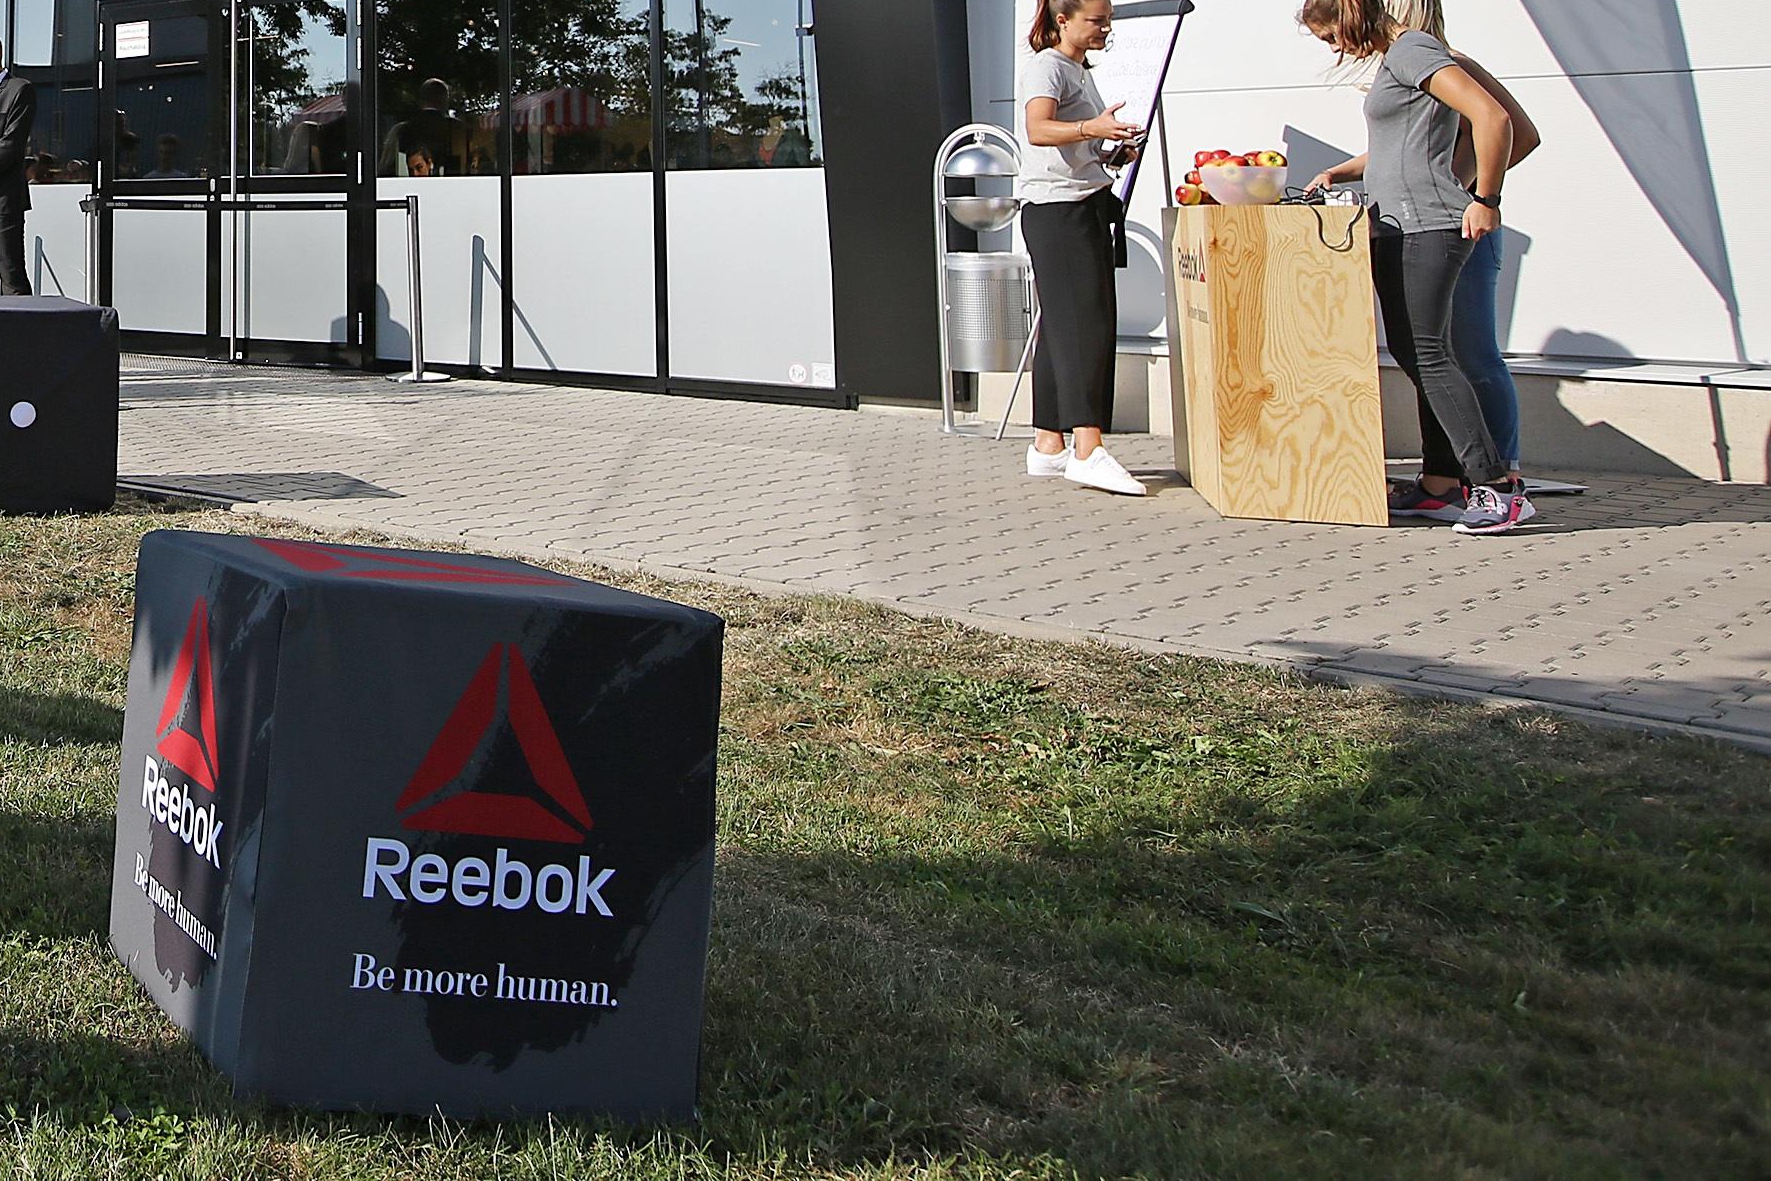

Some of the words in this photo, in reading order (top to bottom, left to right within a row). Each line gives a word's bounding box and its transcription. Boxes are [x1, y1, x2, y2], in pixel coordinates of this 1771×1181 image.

[142, 754, 224, 870] Reebok
[134, 852, 148, 892] Be
[148, 874, 175, 919] more
[175, 890, 218, 960] human.
[362, 837, 617, 916] Reebok
[349, 953, 395, 990] Be
[401, 968, 488, 997] more
[494, 963, 619, 1006] human.
